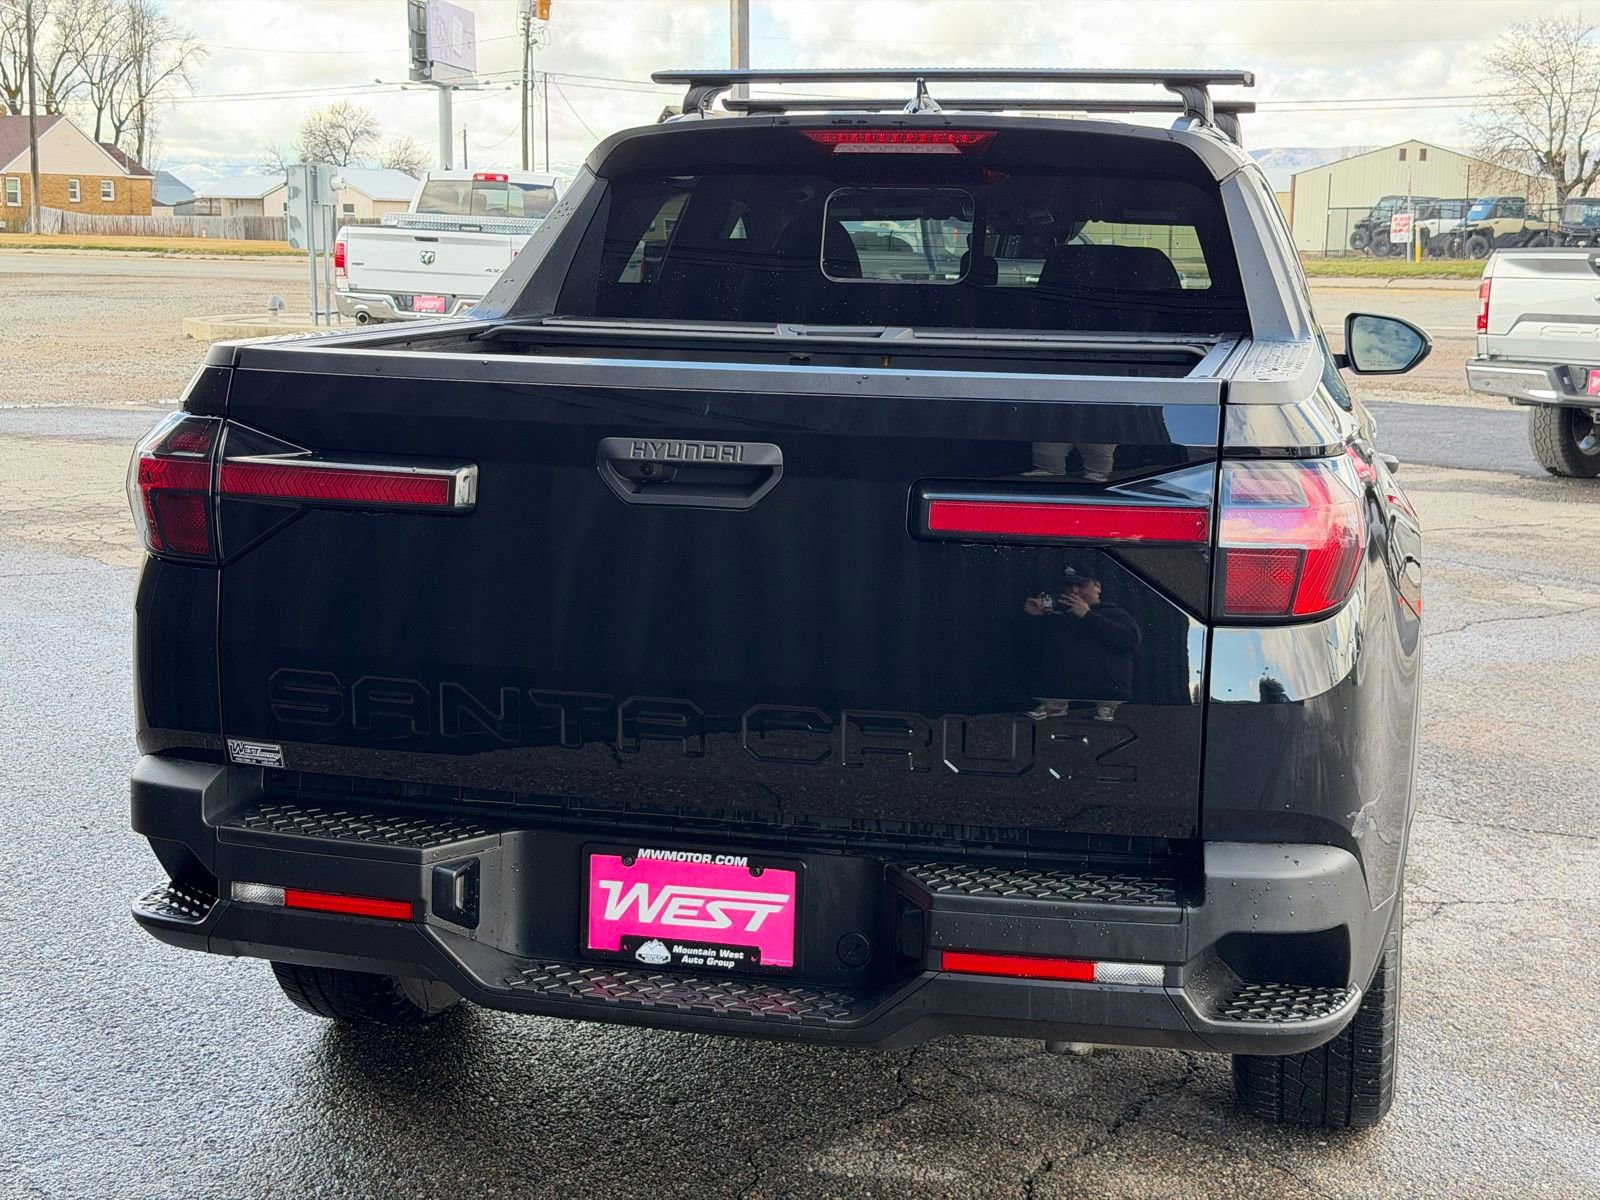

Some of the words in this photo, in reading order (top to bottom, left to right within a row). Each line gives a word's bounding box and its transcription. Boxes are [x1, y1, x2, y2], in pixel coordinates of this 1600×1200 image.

[630, 441, 745, 462] HYUNDAI
[268, 668, 705, 758] SANTA
[742, 703, 1138, 783] CRUZ
[637, 848, 748, 867] MWMOTOR.COM
[599, 880, 791, 932] WEST
[672, 945, 717, 957] Mountain
[719, 949, 745, 960] West
[681, 954, 705, 965] Auto
[706, 956, 735, 969] Group
